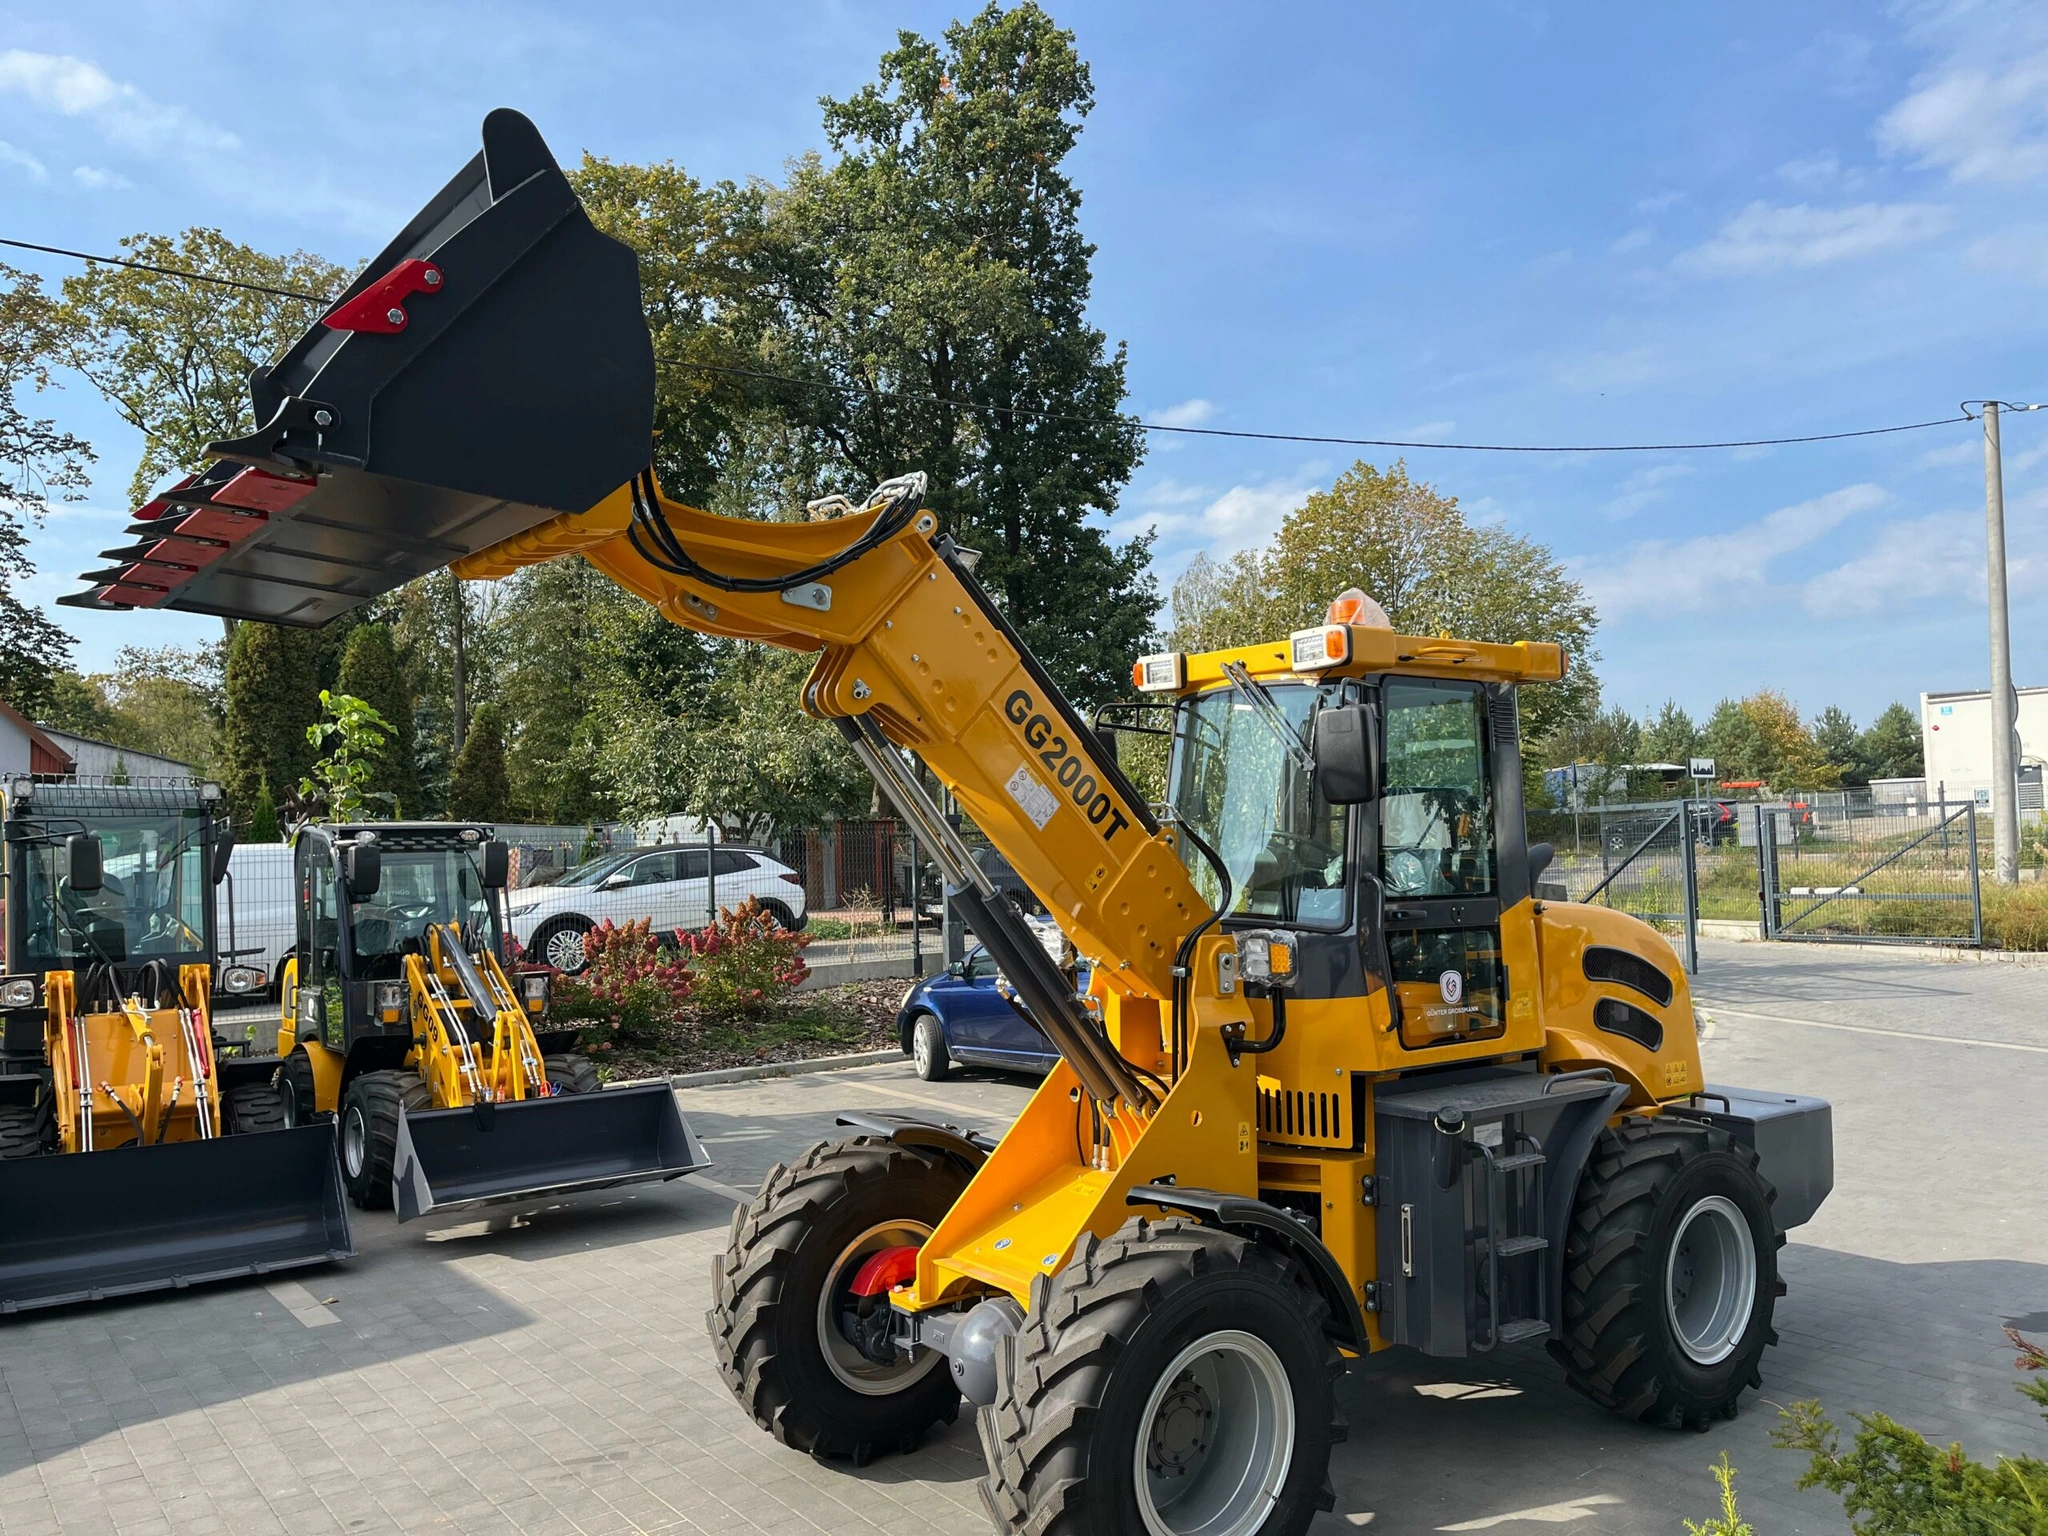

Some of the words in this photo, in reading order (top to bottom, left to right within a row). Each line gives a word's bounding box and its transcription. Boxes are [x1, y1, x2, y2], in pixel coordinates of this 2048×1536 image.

[1004, 689, 1130, 842] GG2000T
[1426, 1007, 1448, 1017] GÜNTER
[1448, 1005, 1479, 1015] GROSSMANN
